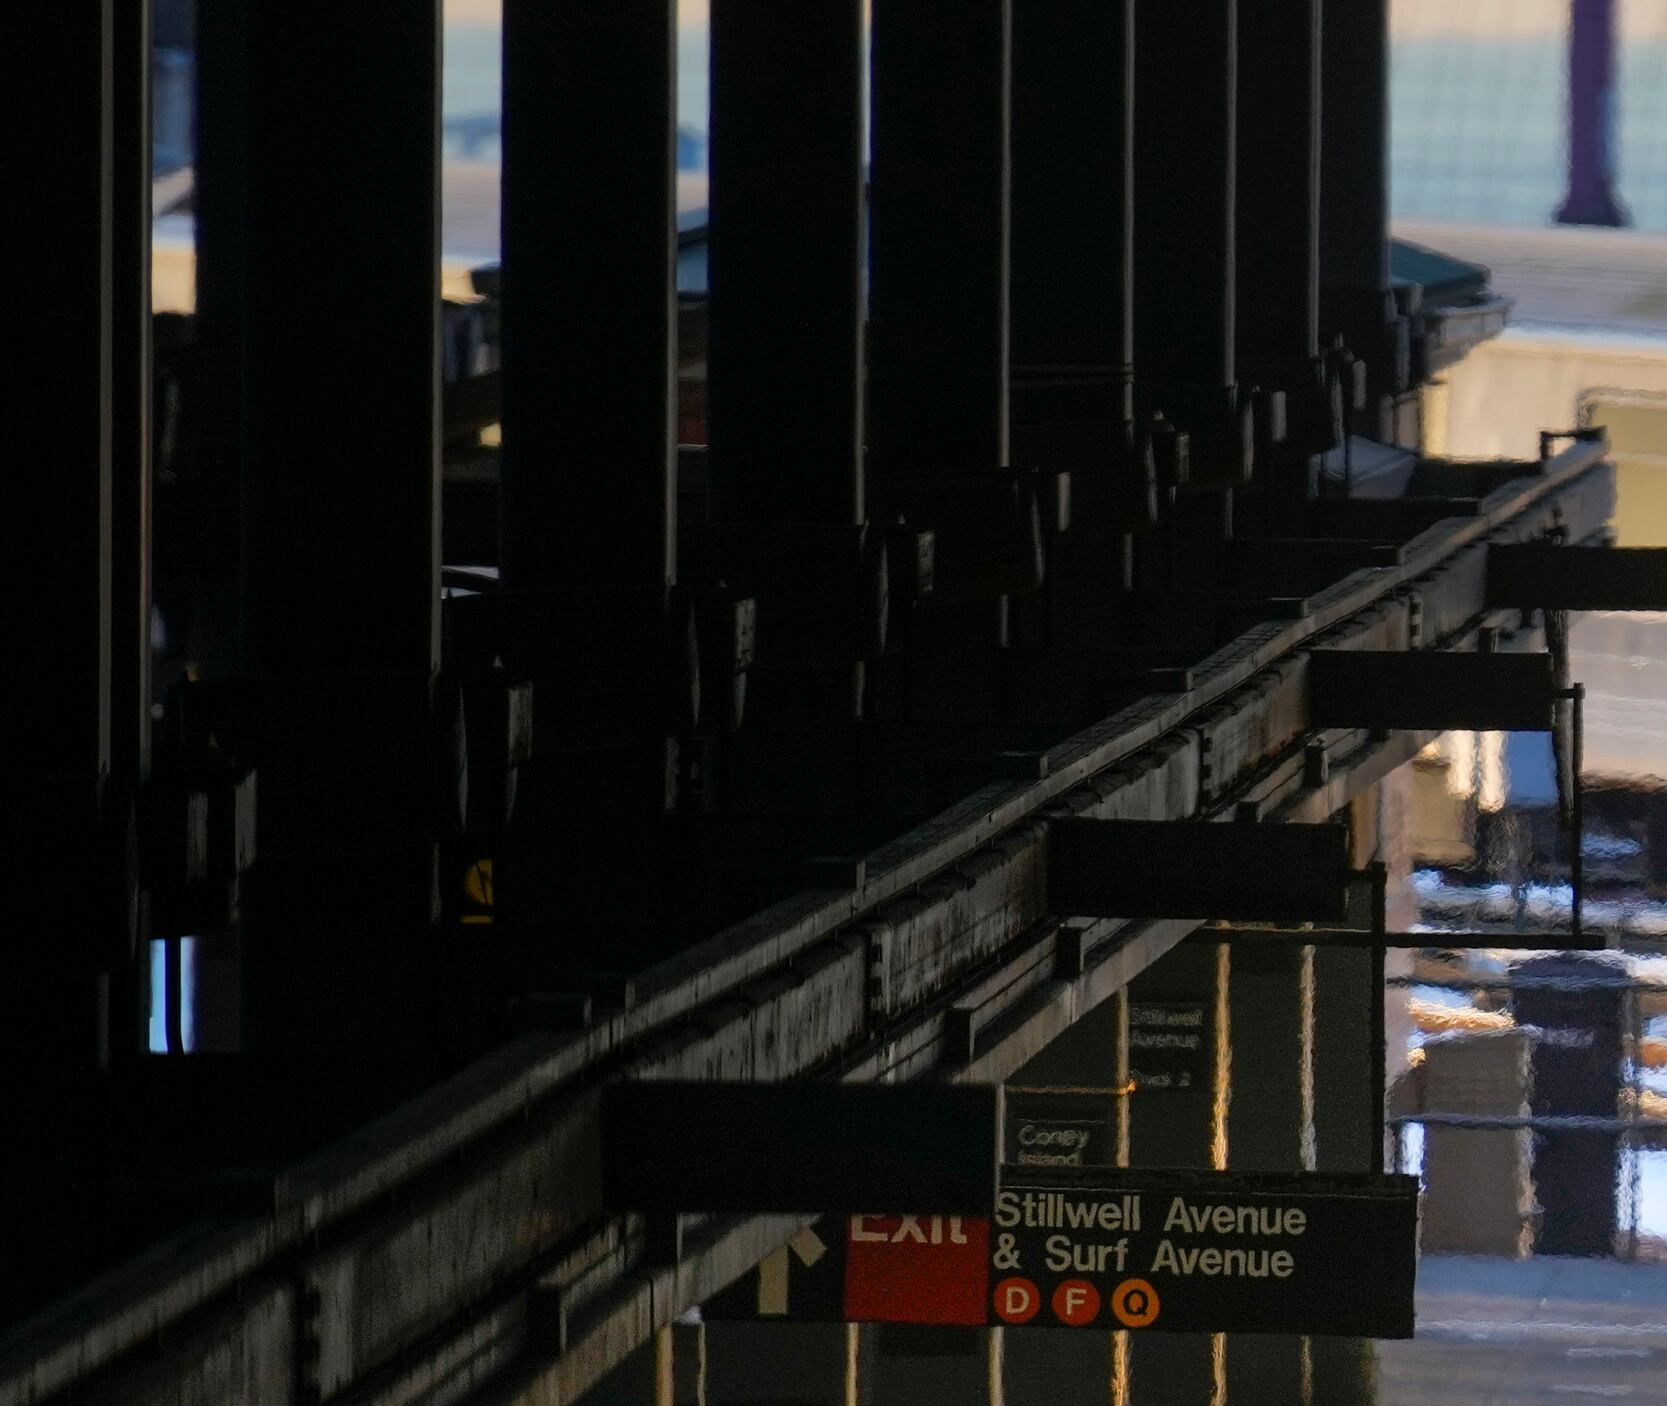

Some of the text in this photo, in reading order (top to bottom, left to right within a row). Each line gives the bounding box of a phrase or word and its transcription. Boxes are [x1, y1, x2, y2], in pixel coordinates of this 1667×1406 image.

[994, 1191, 1307, 1235] Stillwell Avenue
[992, 1232, 1295, 1278] & Surf Avenue
[1005, 1286, 1148, 1316] D F Q
